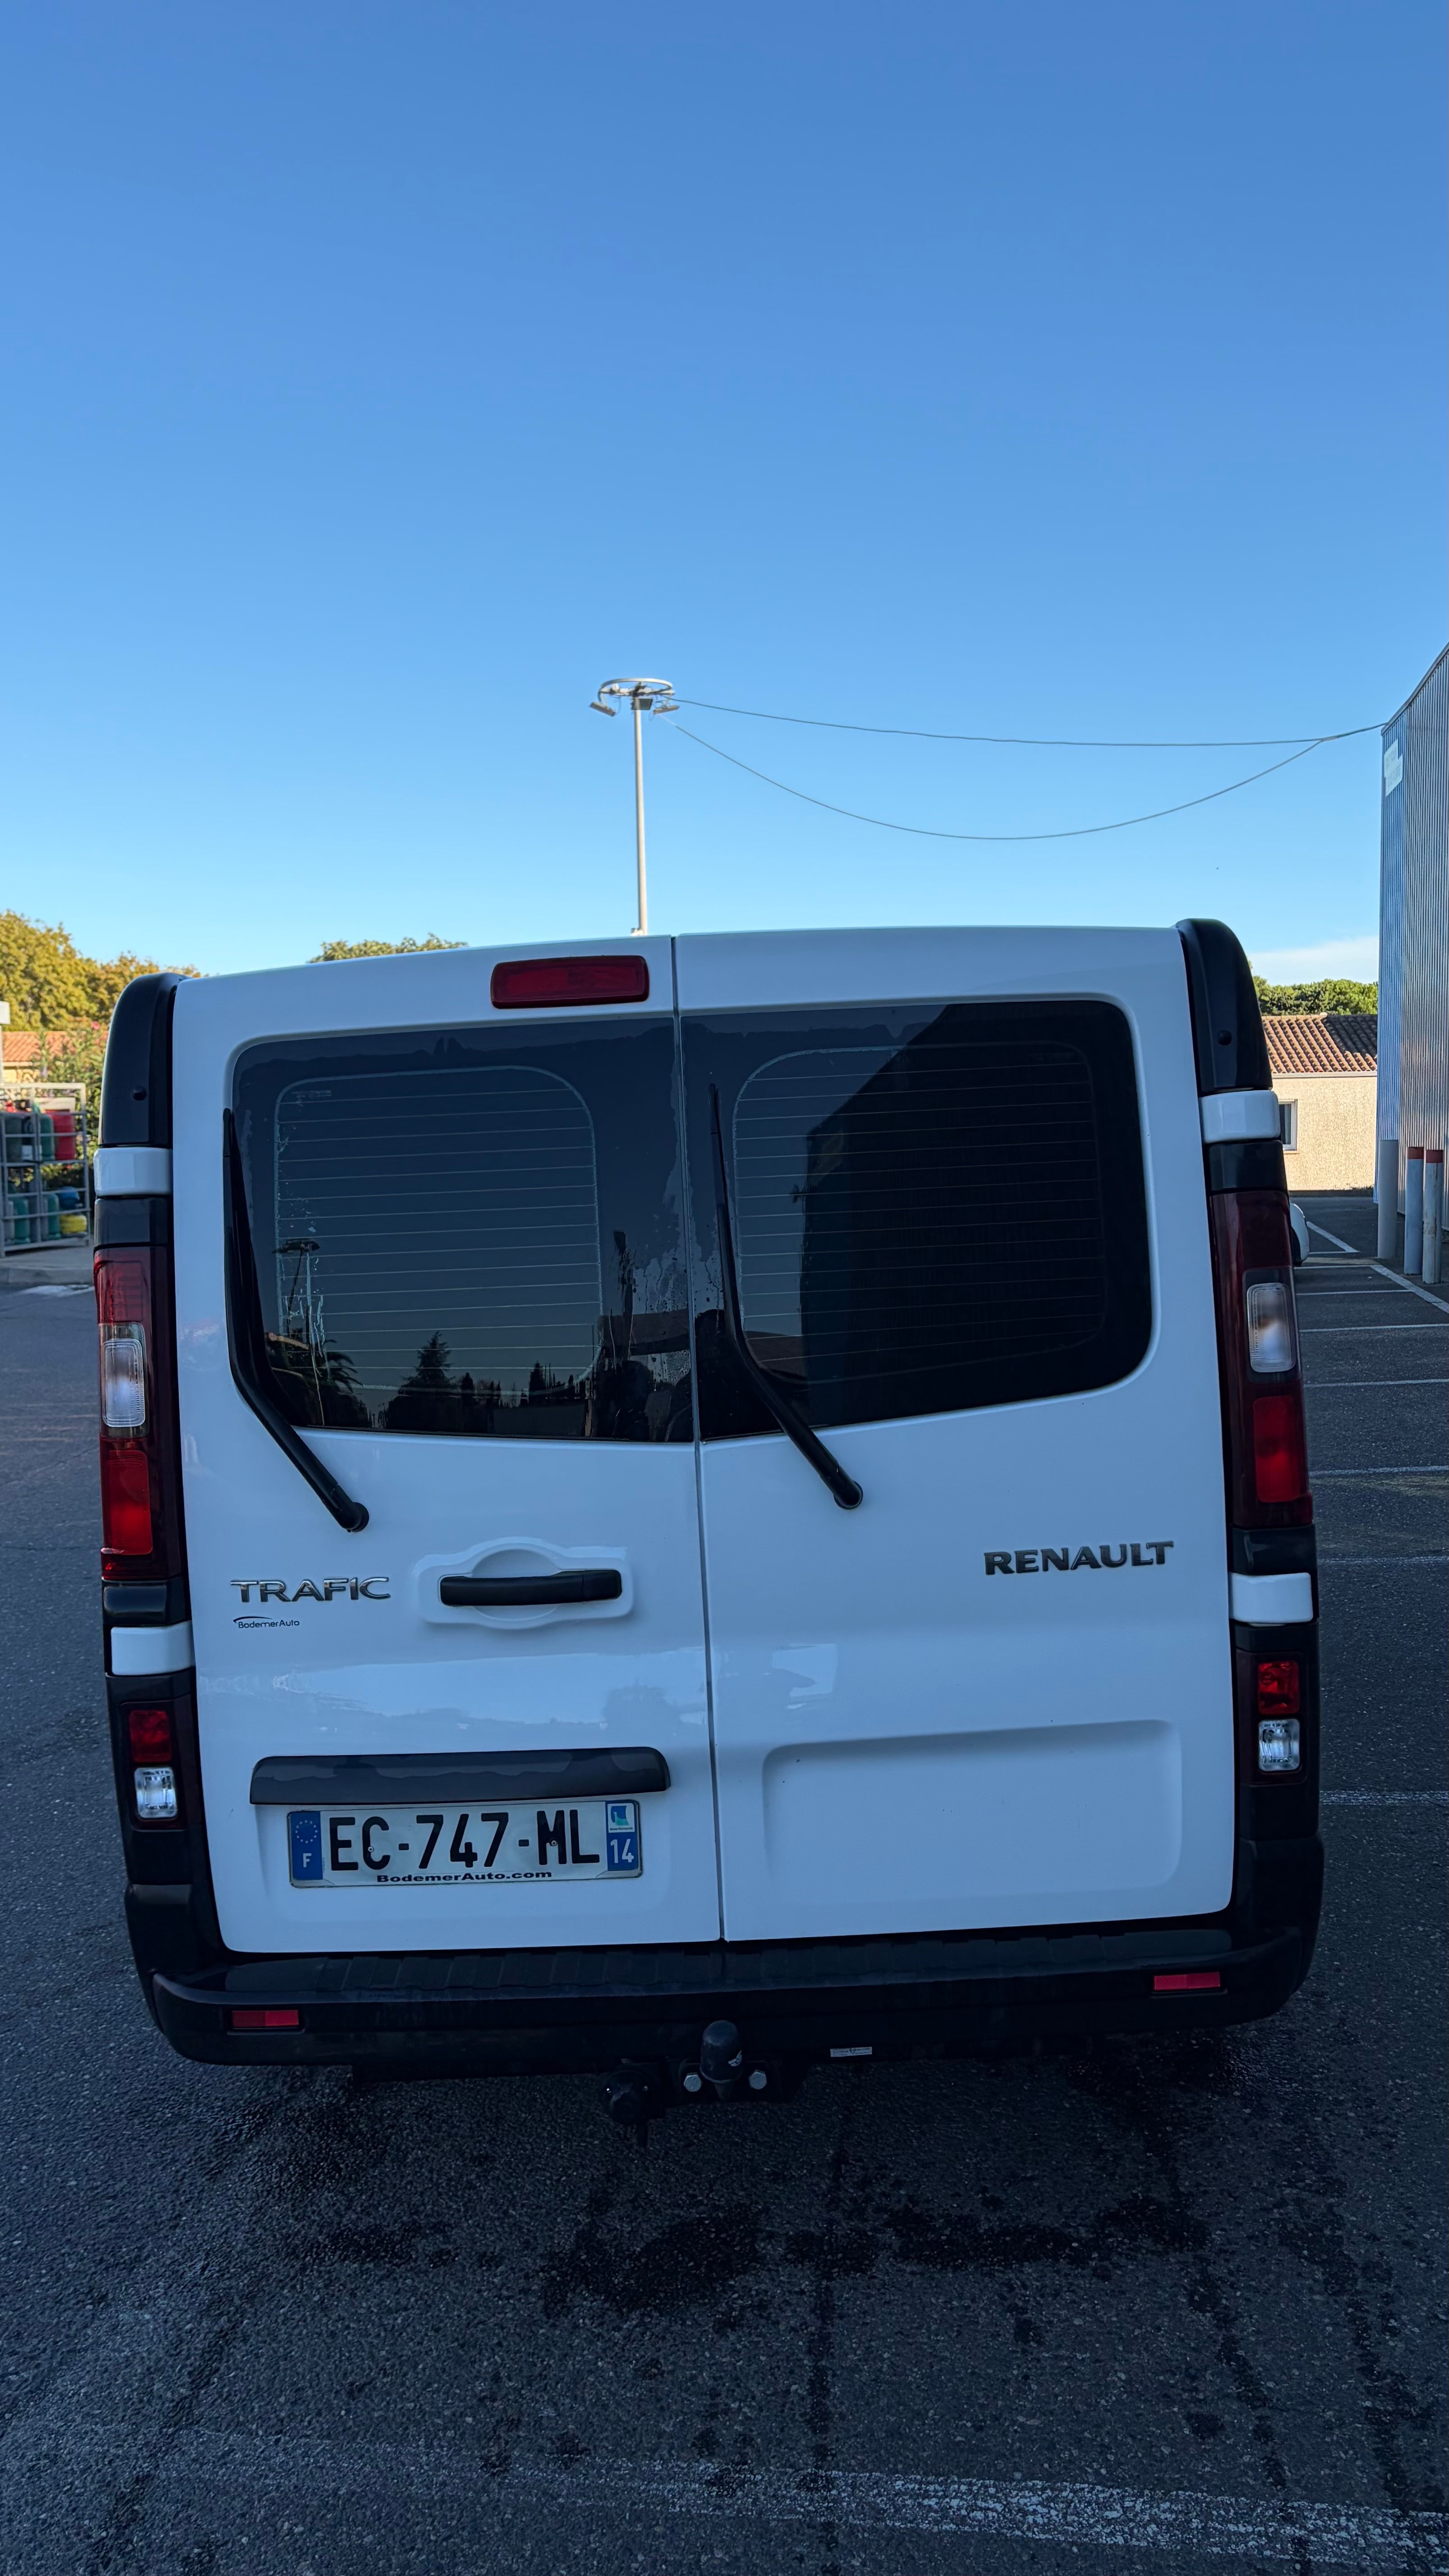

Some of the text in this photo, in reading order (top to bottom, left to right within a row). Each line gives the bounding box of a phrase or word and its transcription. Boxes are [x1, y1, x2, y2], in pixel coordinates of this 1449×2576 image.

[984, 1541, 1174, 1575] RENAULT
[230, 1577, 391, 1603] TRAFIC
[329, 1809, 600, 1871] EC-747-ML
[610, 1839, 634, 1863] 14
[302, 1853, 312, 1868] F
[377, 1871, 552, 1883] BodemerAuto.com
